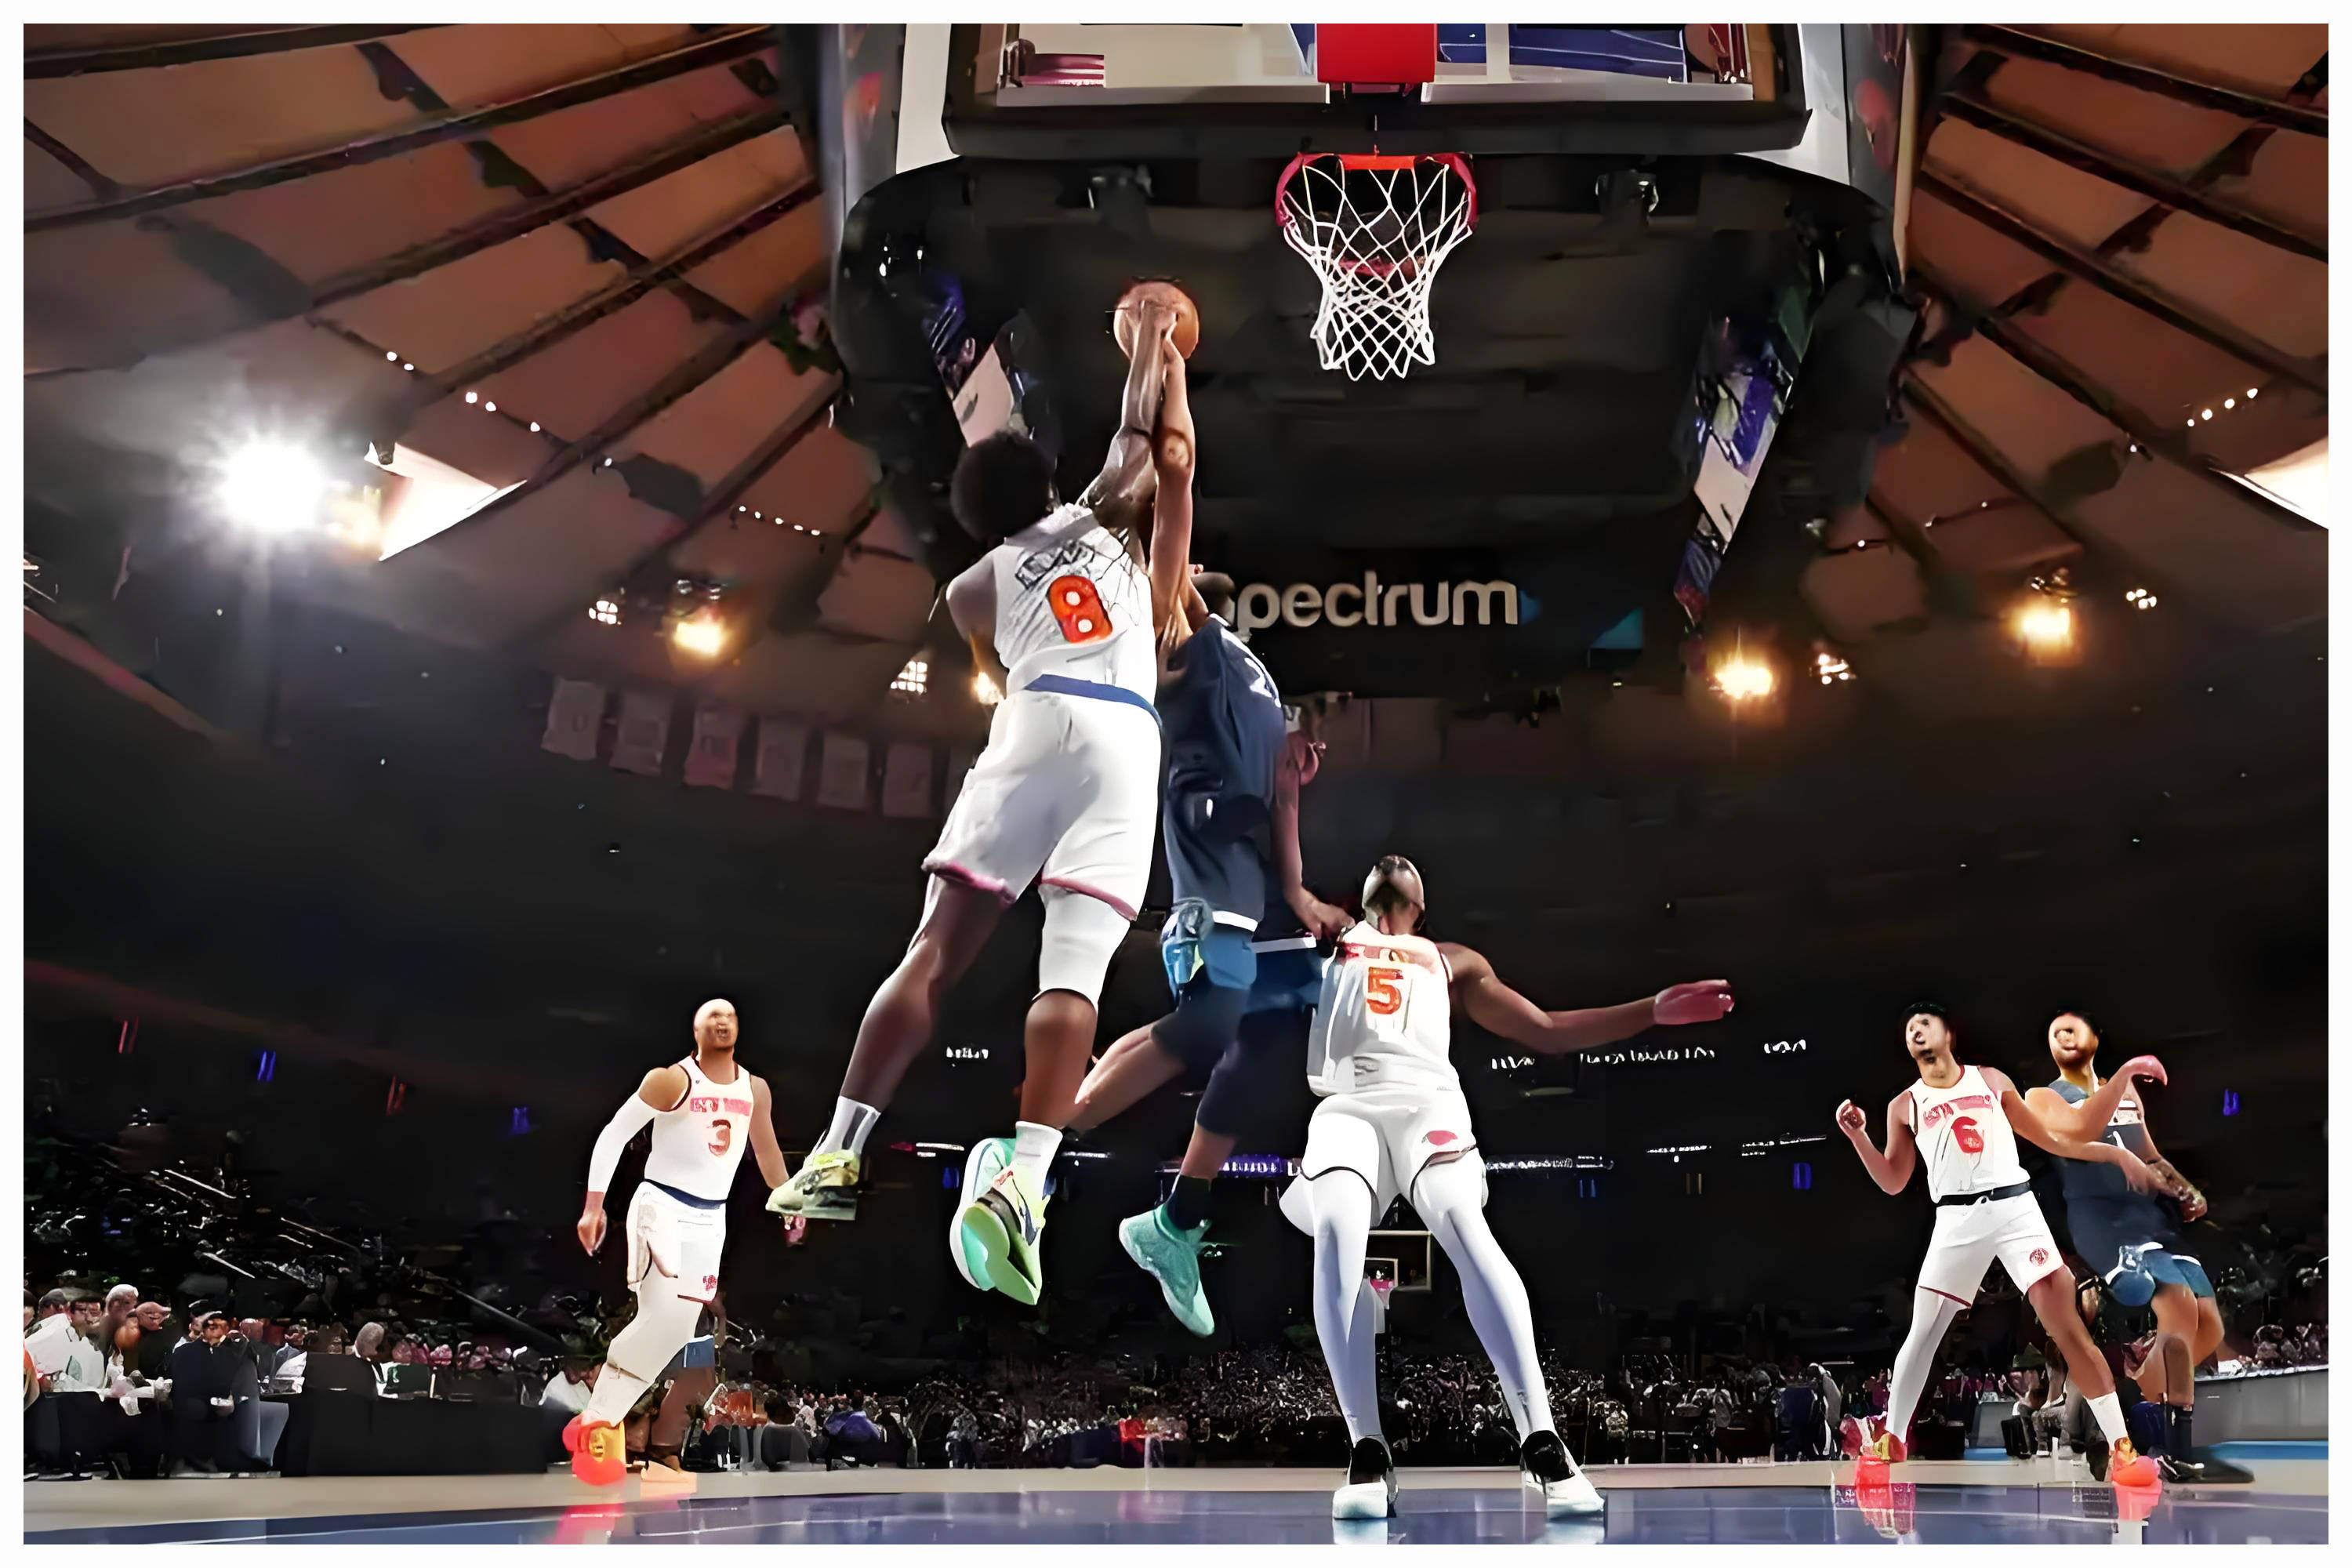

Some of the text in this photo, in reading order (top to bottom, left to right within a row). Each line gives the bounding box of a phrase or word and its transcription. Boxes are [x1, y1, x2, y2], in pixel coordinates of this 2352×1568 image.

[1047, 575, 1113, 643] 8
[1225, 570, 1519, 642] pectrum
[1367, 967, 1403, 1014] 5
[708, 1119, 731, 1156] 3
[1951, 1116, 1984, 1154] 6
